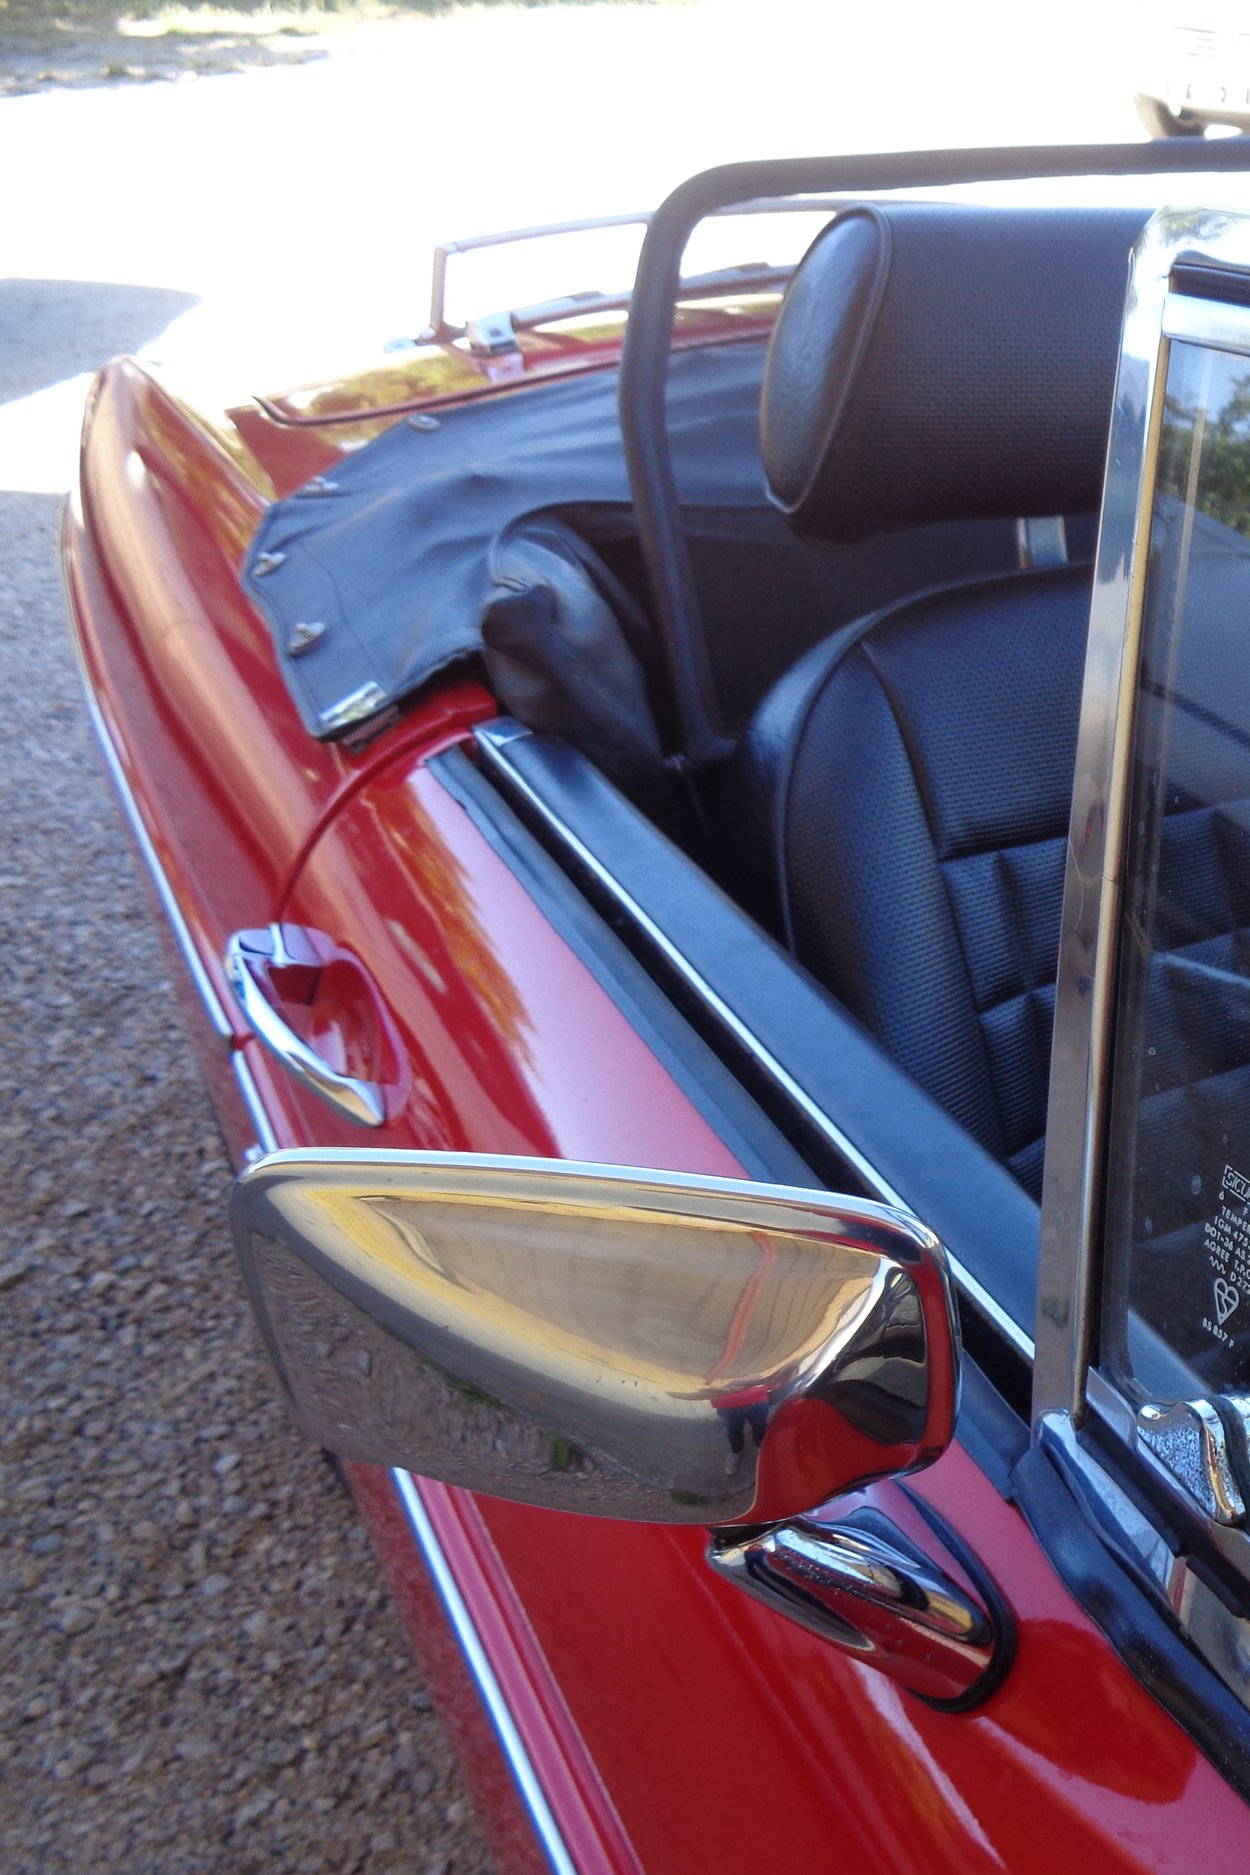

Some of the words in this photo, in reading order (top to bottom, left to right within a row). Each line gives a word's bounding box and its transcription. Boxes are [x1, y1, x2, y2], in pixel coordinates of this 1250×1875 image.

[1243, 1206, 1249, 1216] F
[1214, 1216, 1232, 1235] IGM
[1204, 1238, 1231, 1263] AGREE
[1205, 1222, 1234, 1251] DOT-36
[1235, 1247, 1247, 1261] AS
